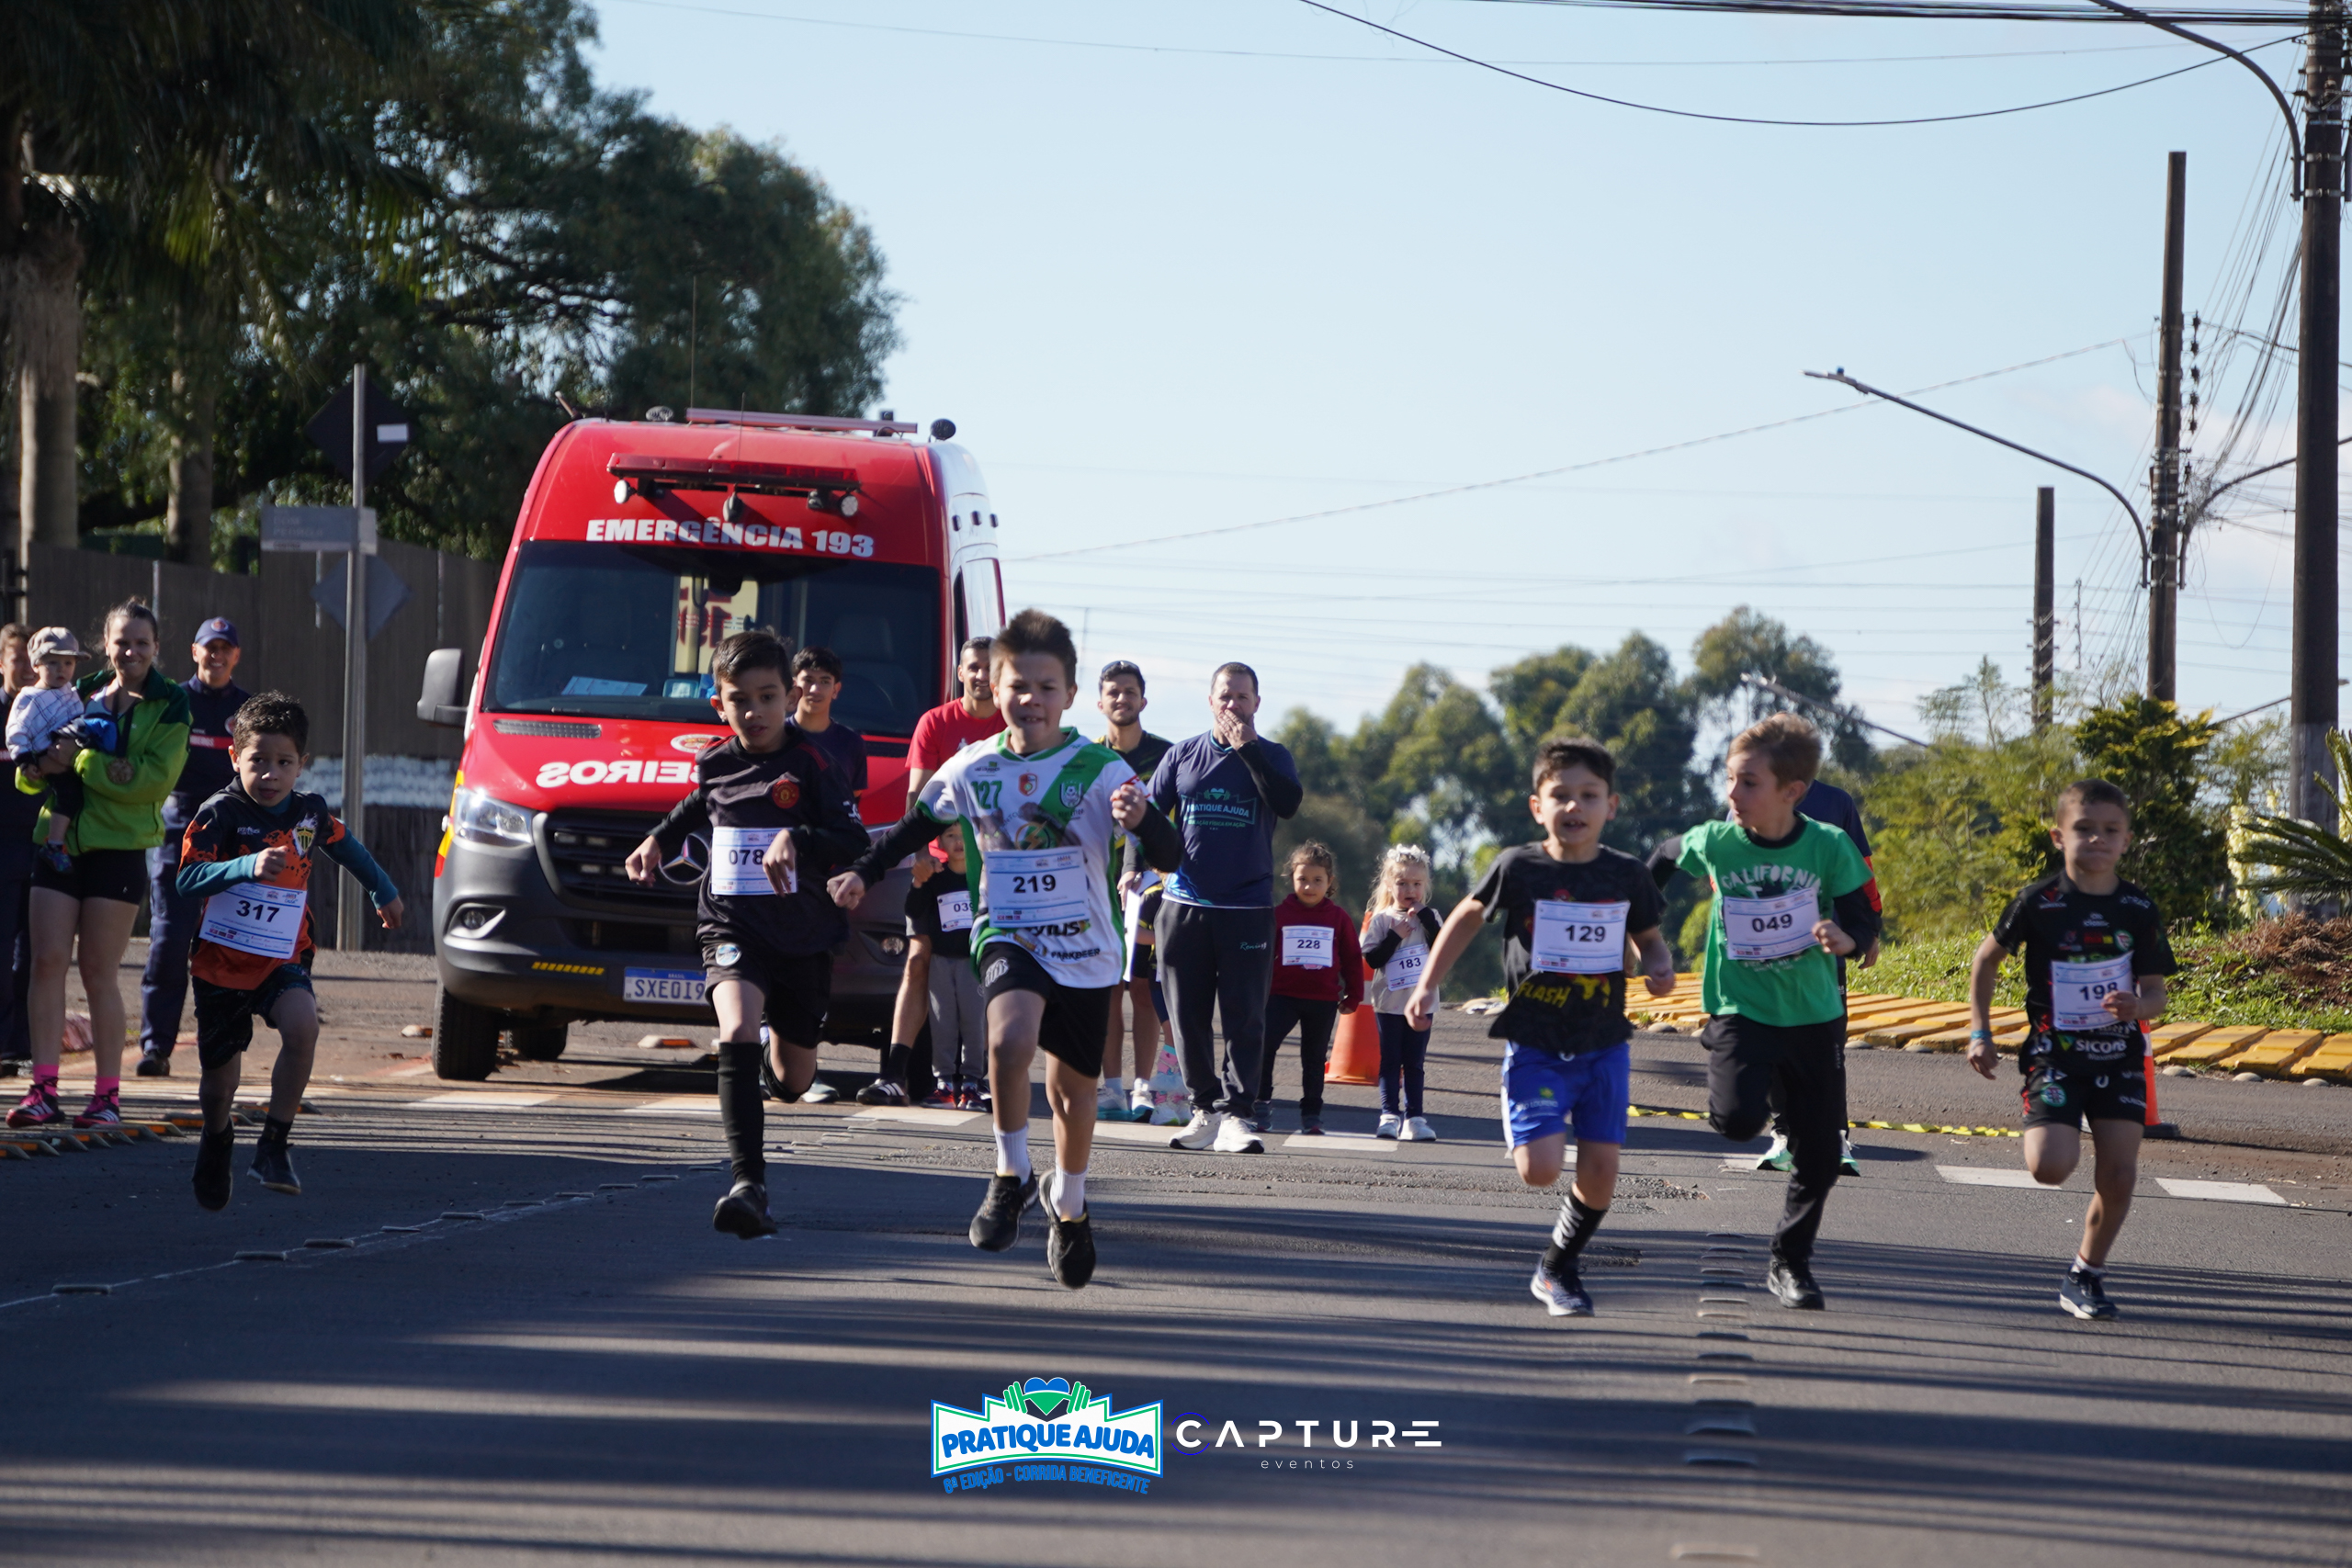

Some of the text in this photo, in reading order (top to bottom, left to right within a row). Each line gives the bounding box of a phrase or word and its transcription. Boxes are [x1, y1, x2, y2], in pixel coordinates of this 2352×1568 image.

[585, 516, 874, 558] EMERGÊNCIA 193
[1222, 805, 1249, 818] AJUDA
[729, 850, 763, 865] 078
[1012, 874, 1057, 894] 219
[1720, 864, 1822, 893] CALIFORNIA
[236, 900, 280, 923] 317
[1565, 924, 1607, 942] 129
[1752, 913, 1793, 933] 049
[1296, 939, 1321, 950] 228
[1398, 957, 1422, 970] 183
[1517, 980, 1572, 1008] FLASH
